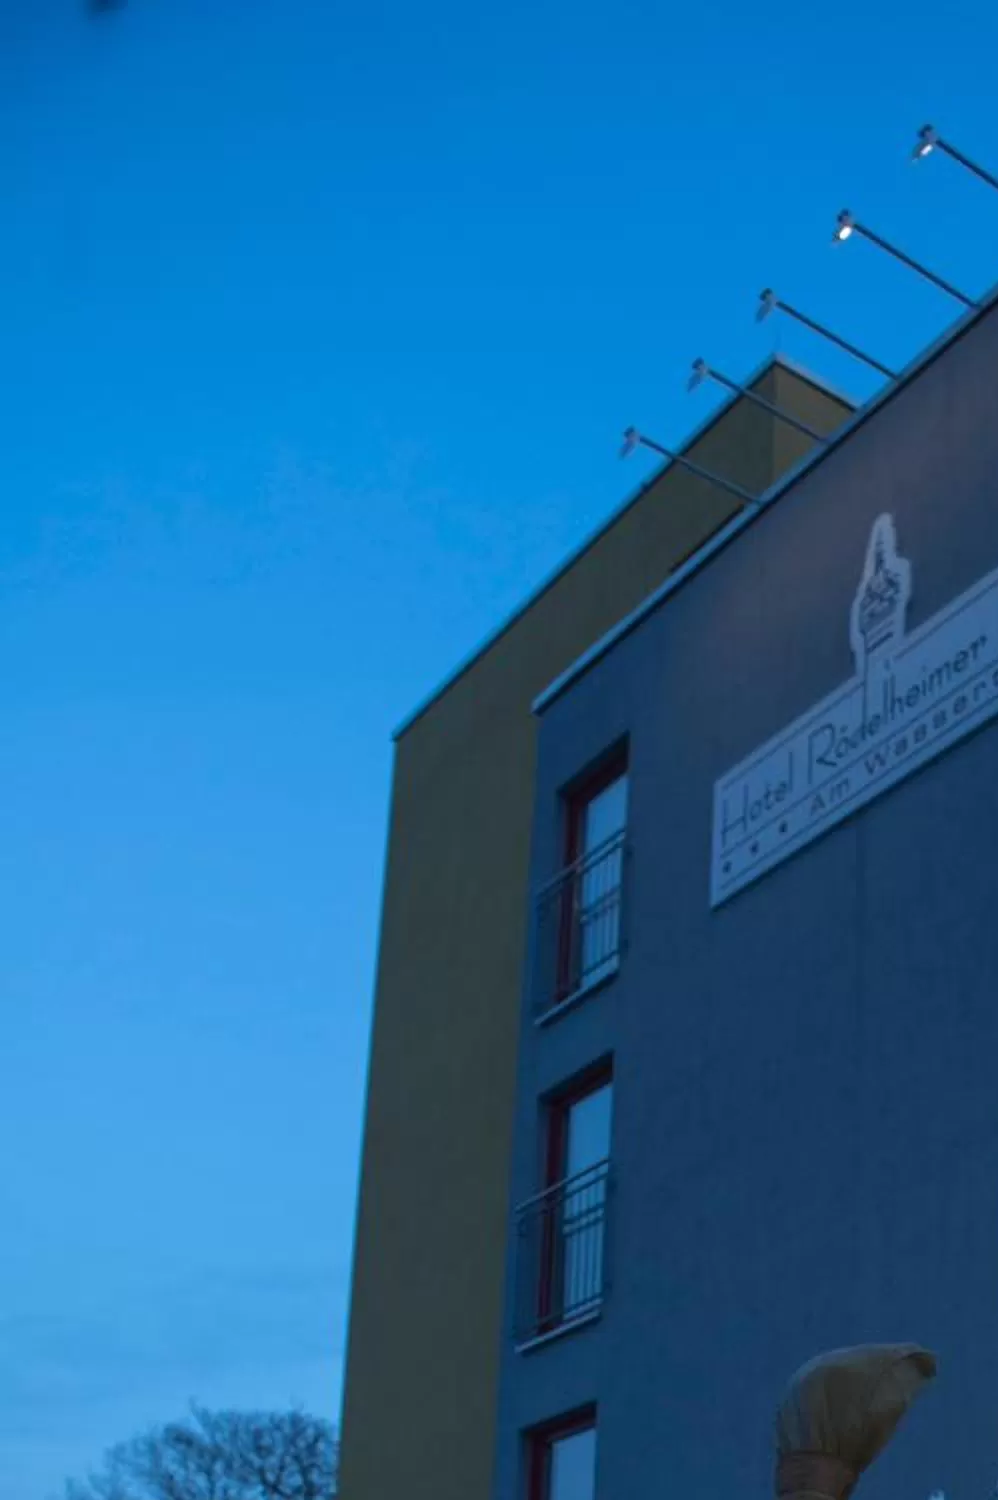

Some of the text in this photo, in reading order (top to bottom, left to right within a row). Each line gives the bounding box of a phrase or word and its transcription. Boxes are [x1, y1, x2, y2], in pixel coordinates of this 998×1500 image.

[721, 750, 794, 847] Hotel
[807, 634, 988, 785] Rödelheimer
[808, 777, 851, 818] Am
